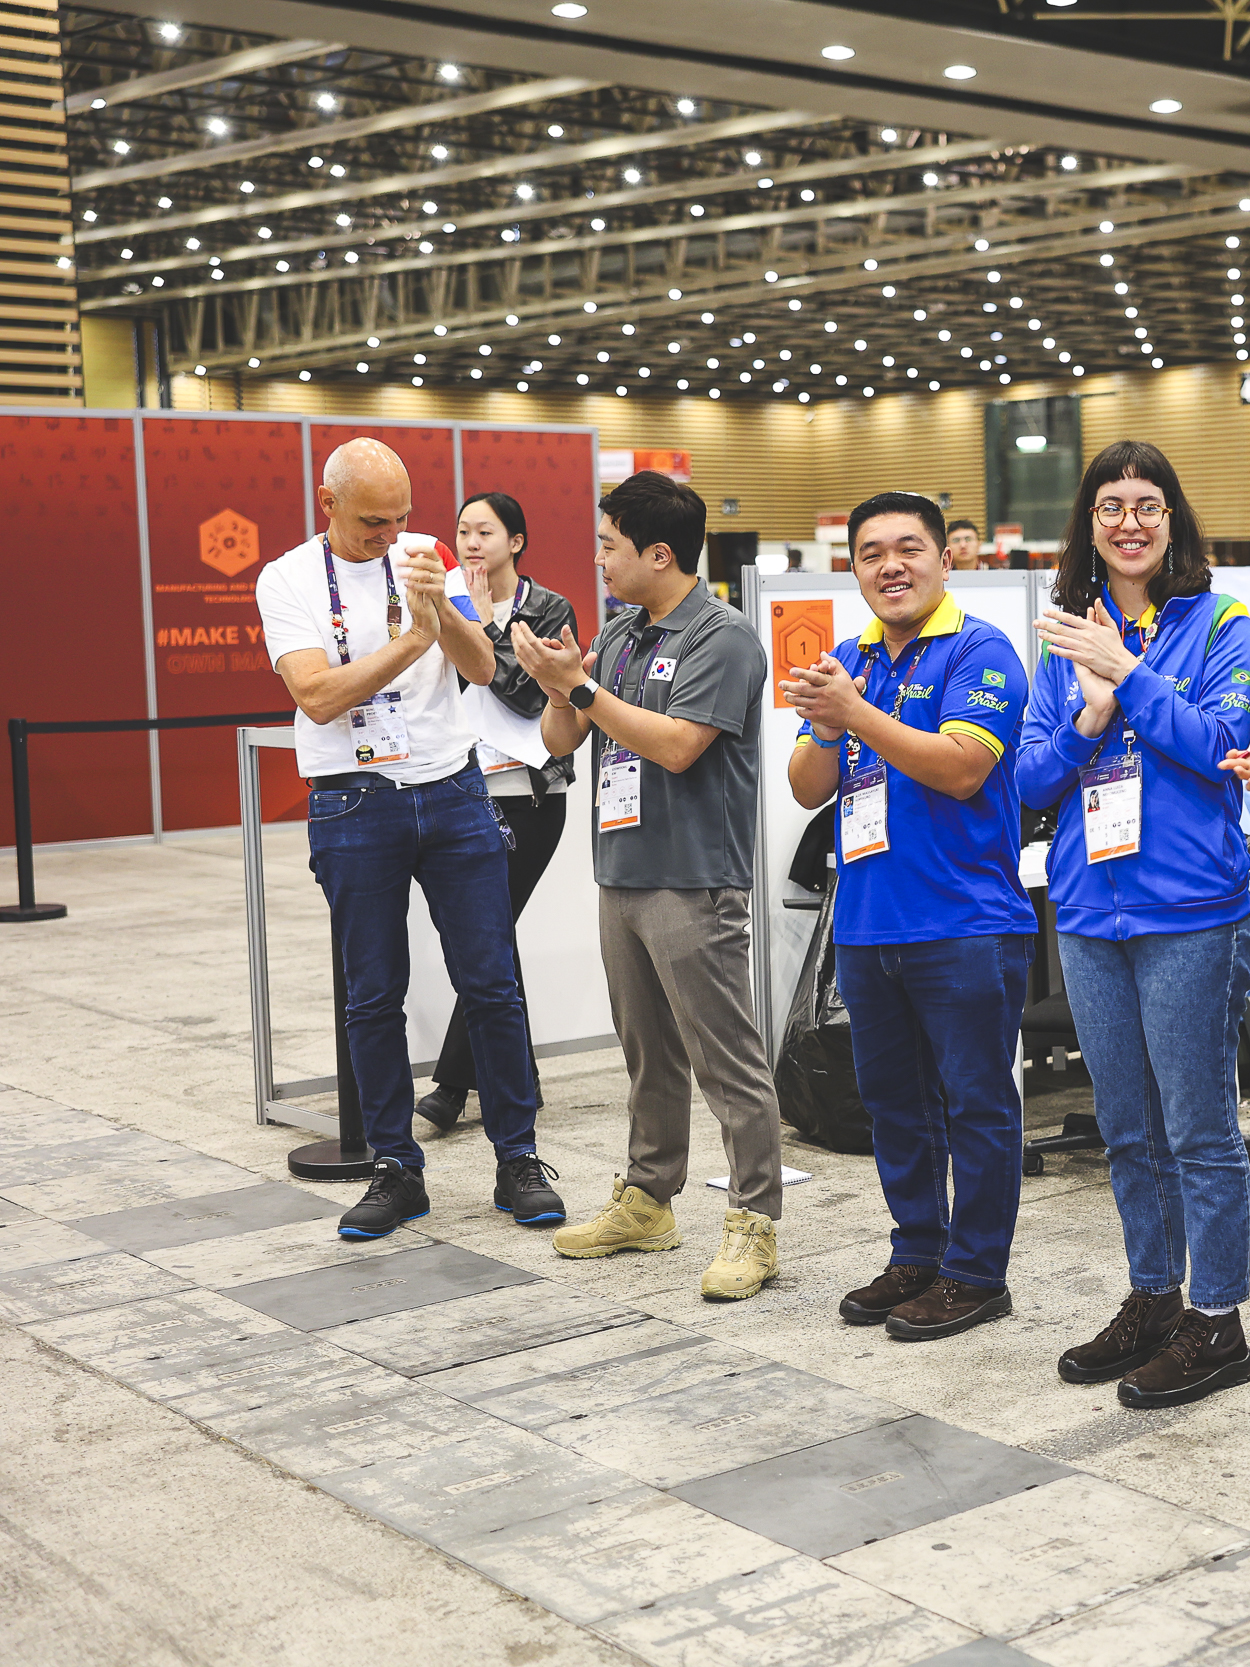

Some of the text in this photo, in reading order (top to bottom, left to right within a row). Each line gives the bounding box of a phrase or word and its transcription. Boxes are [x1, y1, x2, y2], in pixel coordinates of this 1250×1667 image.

[157, 625, 265, 647] #MAKE Y
[800, 641, 806, 656] 1
[966, 690, 1009, 714] Brazil
